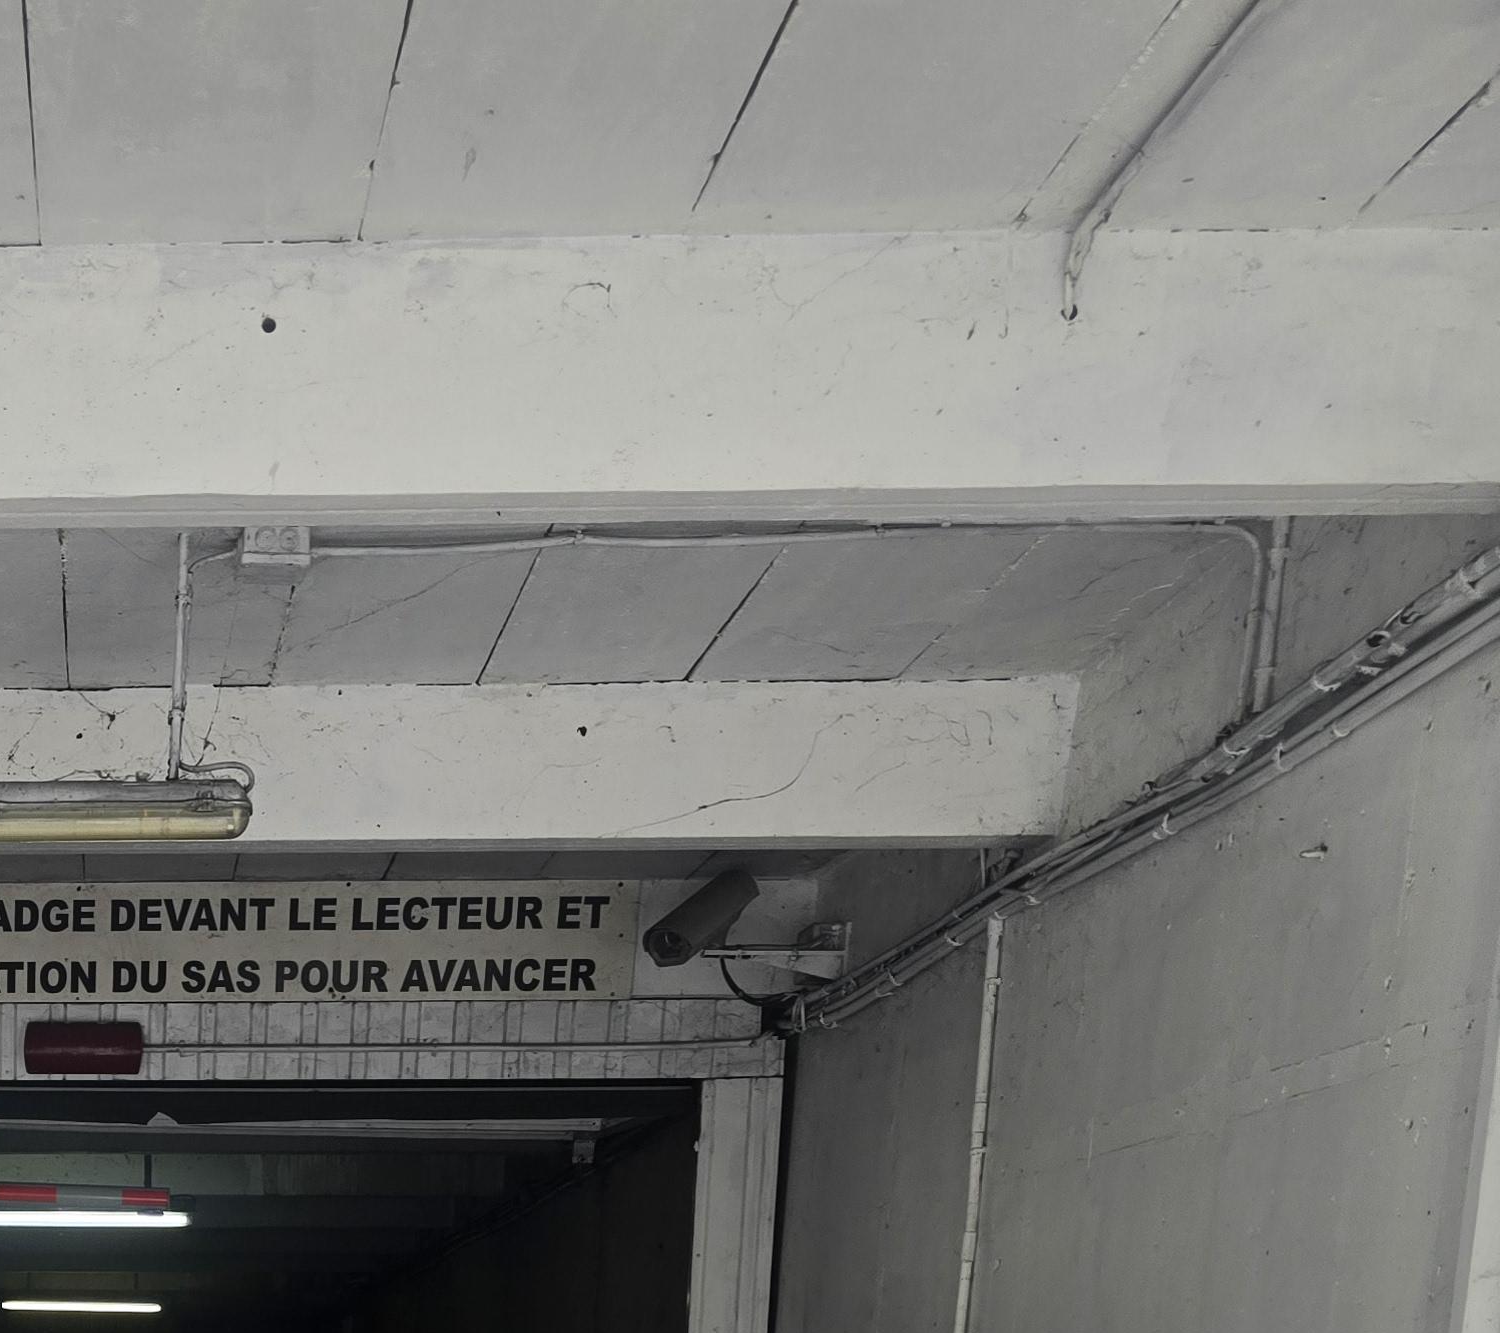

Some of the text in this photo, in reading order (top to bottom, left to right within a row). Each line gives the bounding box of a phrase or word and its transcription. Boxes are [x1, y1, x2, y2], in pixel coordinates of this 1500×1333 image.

[110, 898, 276, 932] DEVANT
[288, 897, 338, 931] LE
[351, 896, 544, 931] LECTEUR
[556, 895, 611, 930] ET
[111, 960, 168, 994] DU
[181, 960, 261, 994] SAS
[274, 959, 390, 994] POUR
[399, 958, 597, 993] AVANCER
